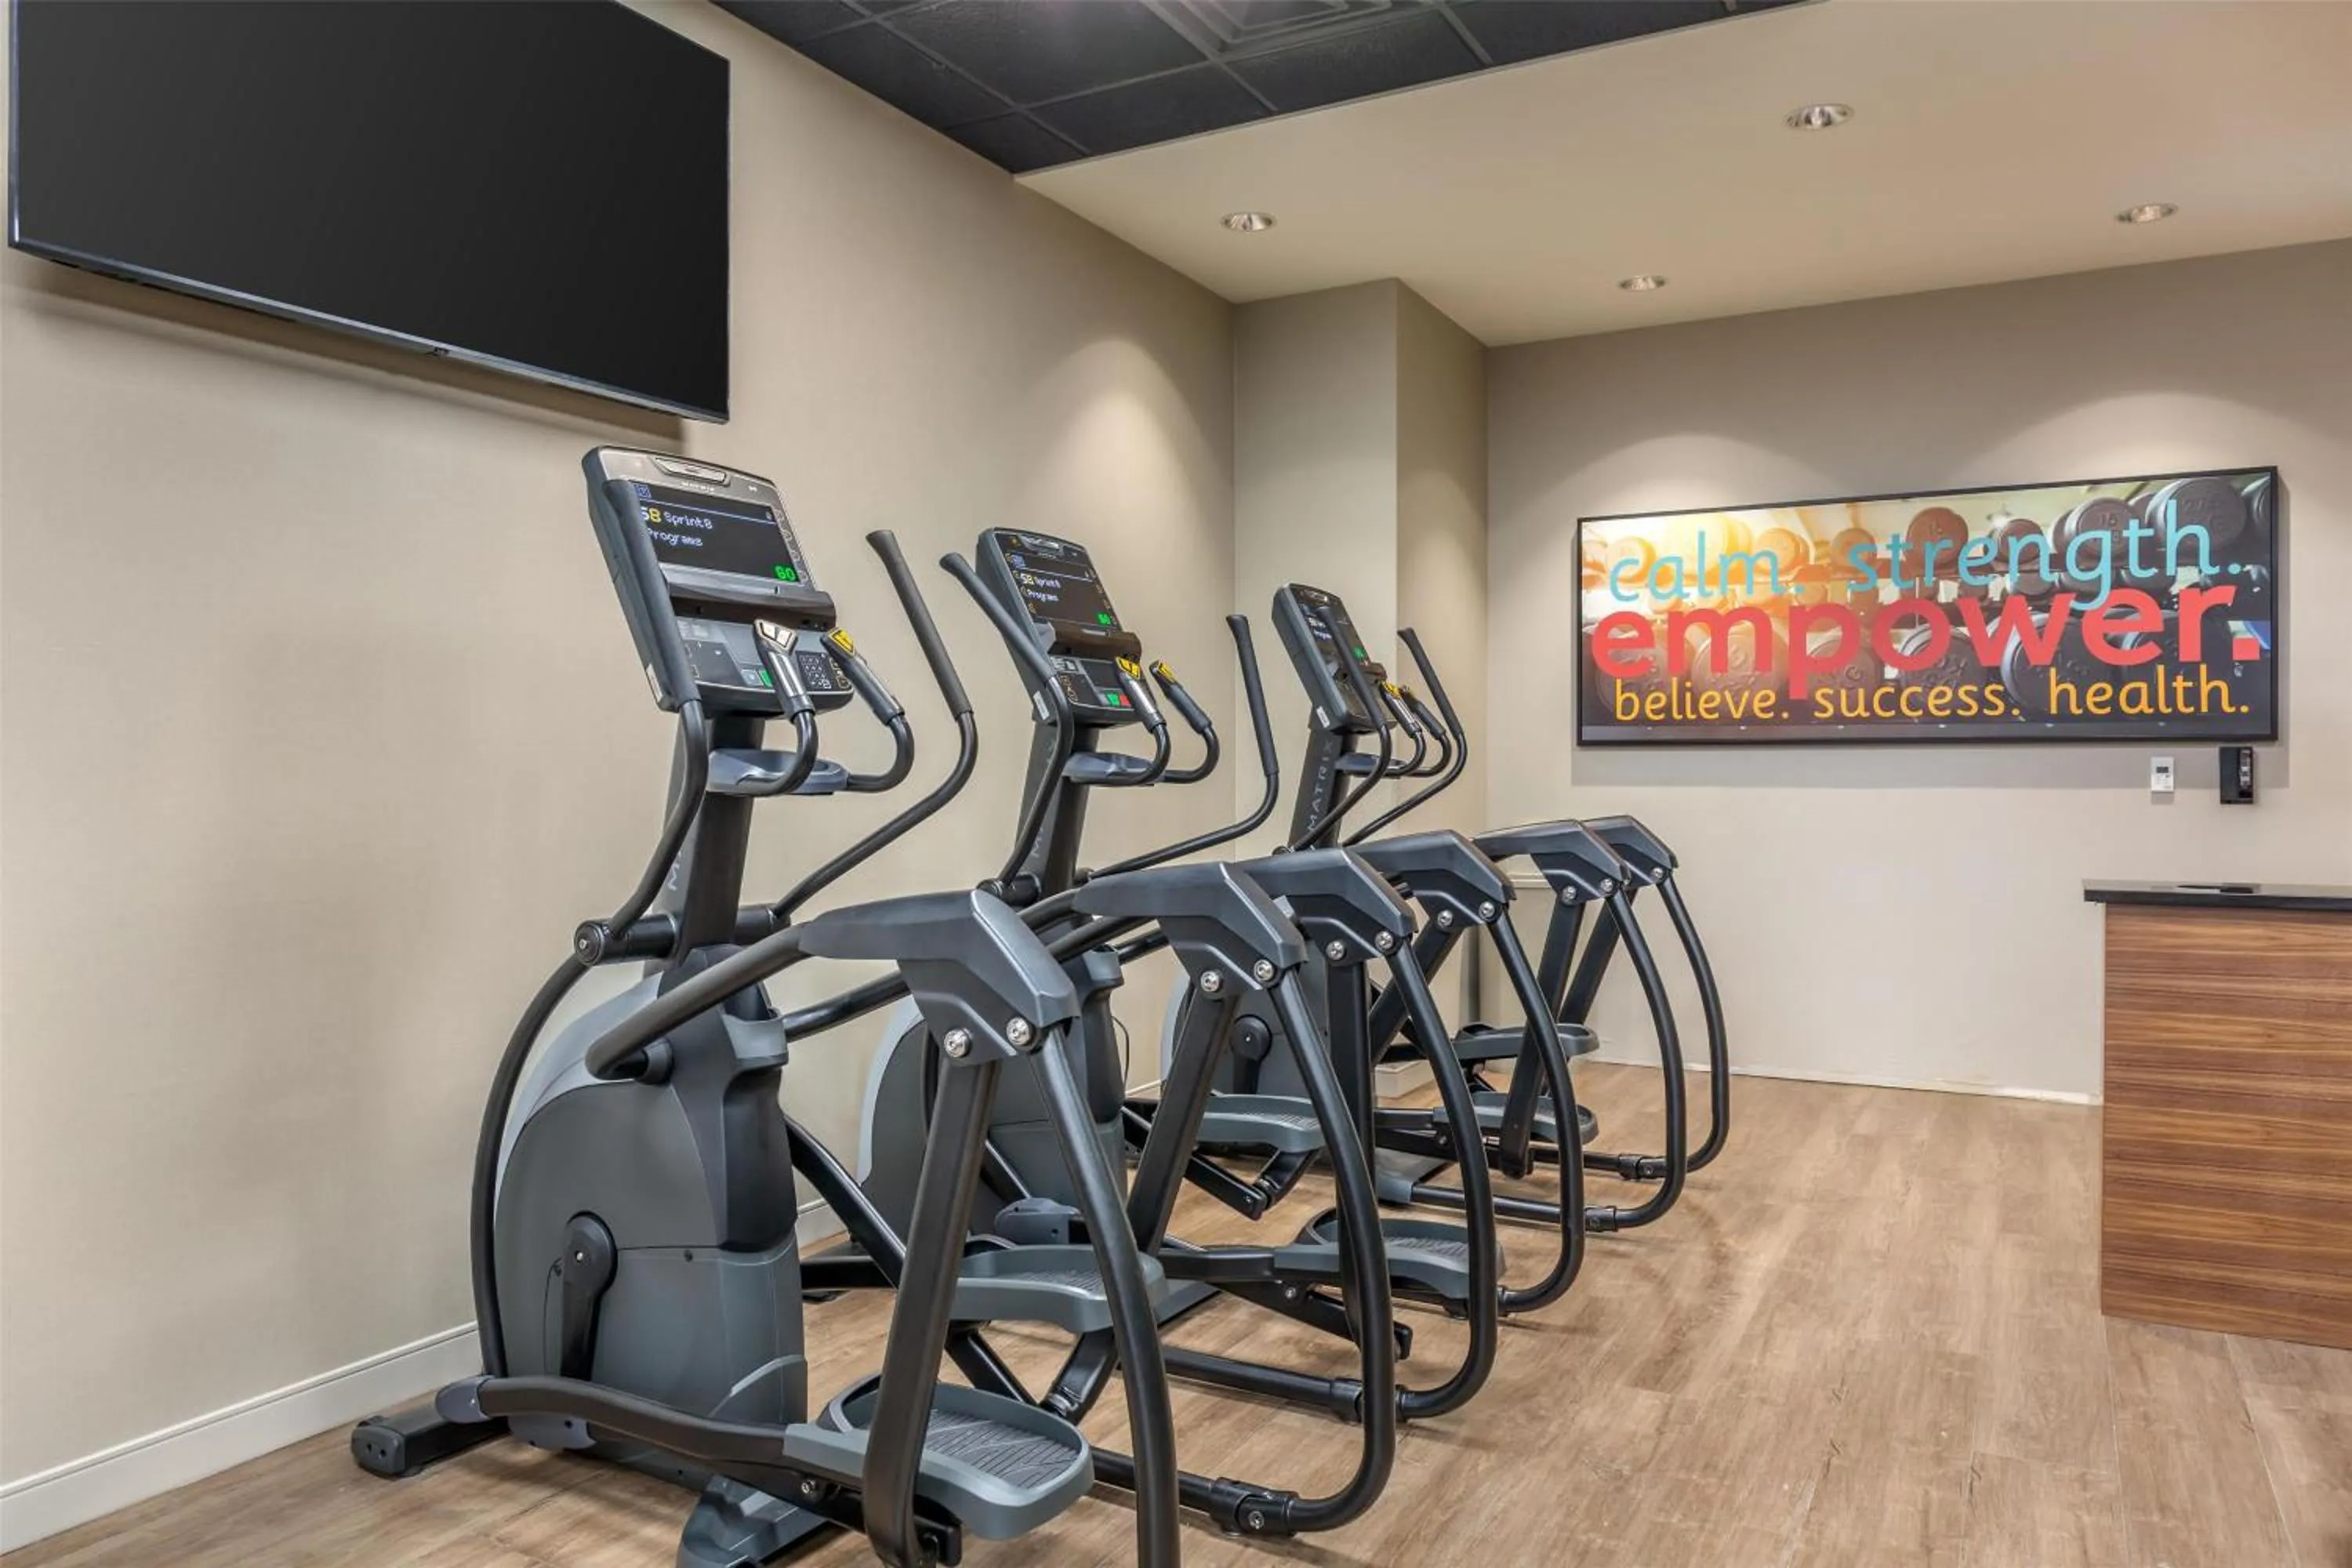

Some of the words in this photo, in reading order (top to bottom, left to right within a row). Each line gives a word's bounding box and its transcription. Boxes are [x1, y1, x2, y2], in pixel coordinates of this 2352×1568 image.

[1610, 530, 1805, 603] calm.
[1847, 499, 2242, 611] strength.
[1592, 585, 2260, 700] empower.
[1615, 677, 1789, 720] believe.
[1813, 683, 2020, 718] success.
[2049, 664, 2249, 716] health.
